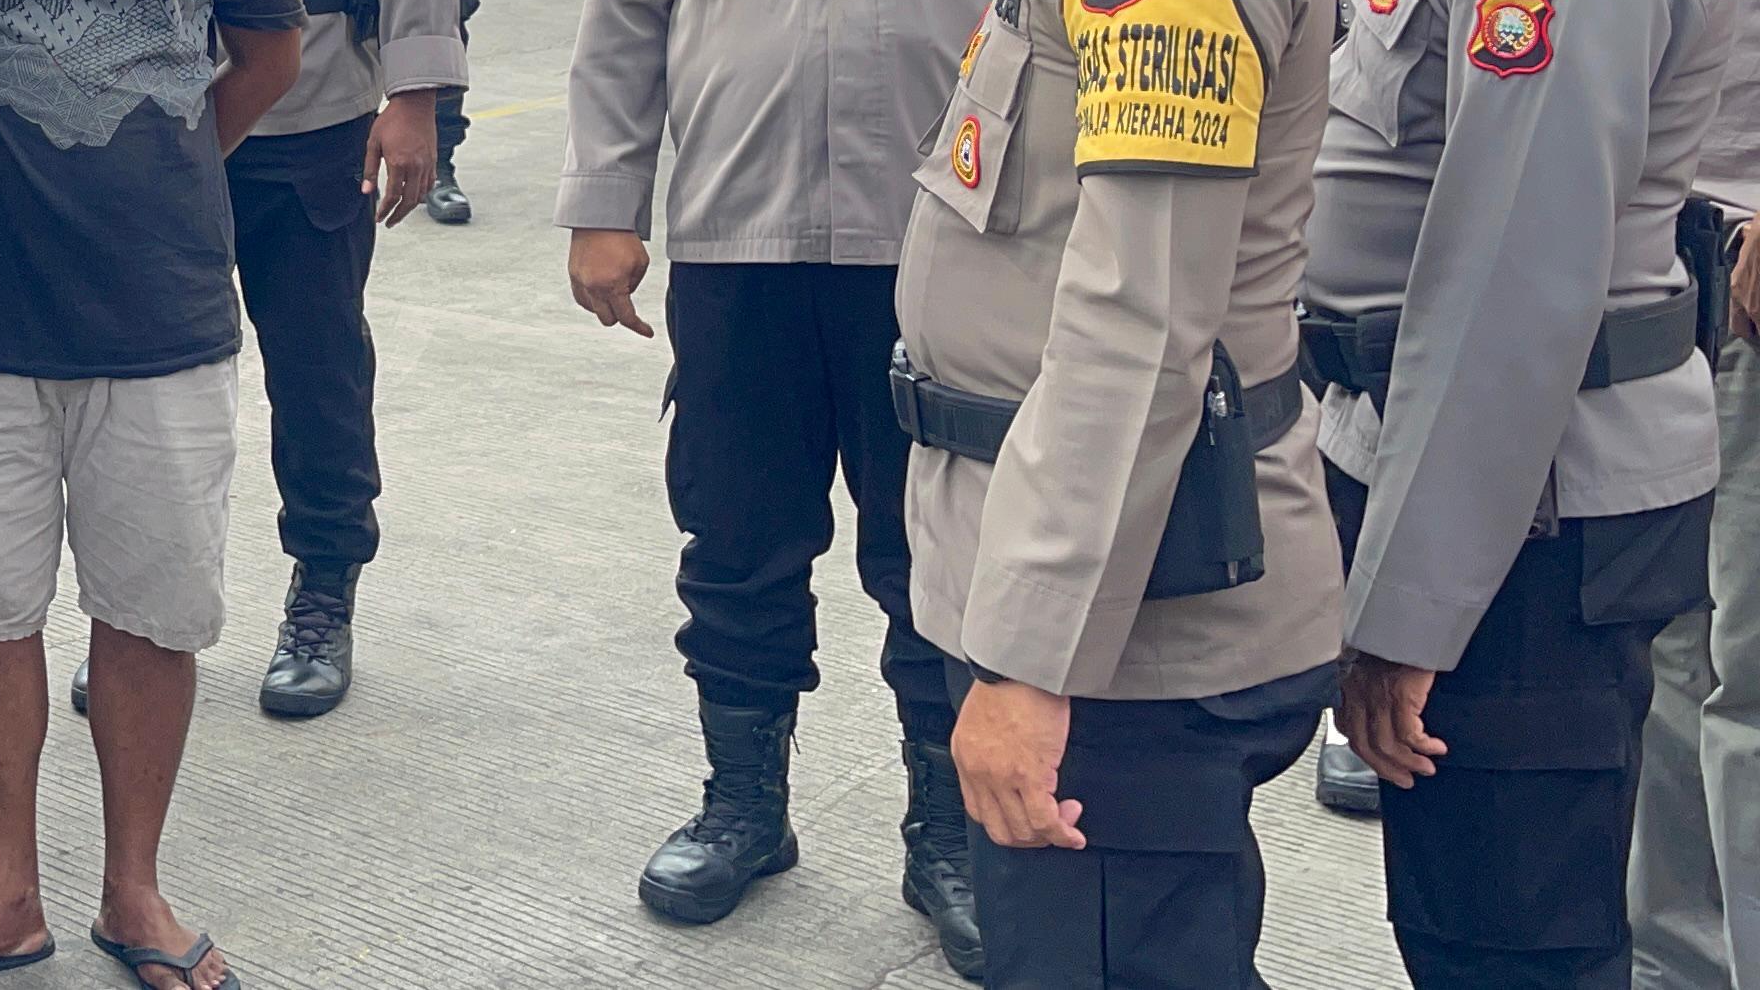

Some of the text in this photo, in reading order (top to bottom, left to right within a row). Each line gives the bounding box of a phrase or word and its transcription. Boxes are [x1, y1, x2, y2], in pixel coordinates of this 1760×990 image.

[1115, 23, 1239, 105] STERILISASI
[1115, 101, 1185, 141] KIERAHA
[1191, 109, 1231, 149] 2024
